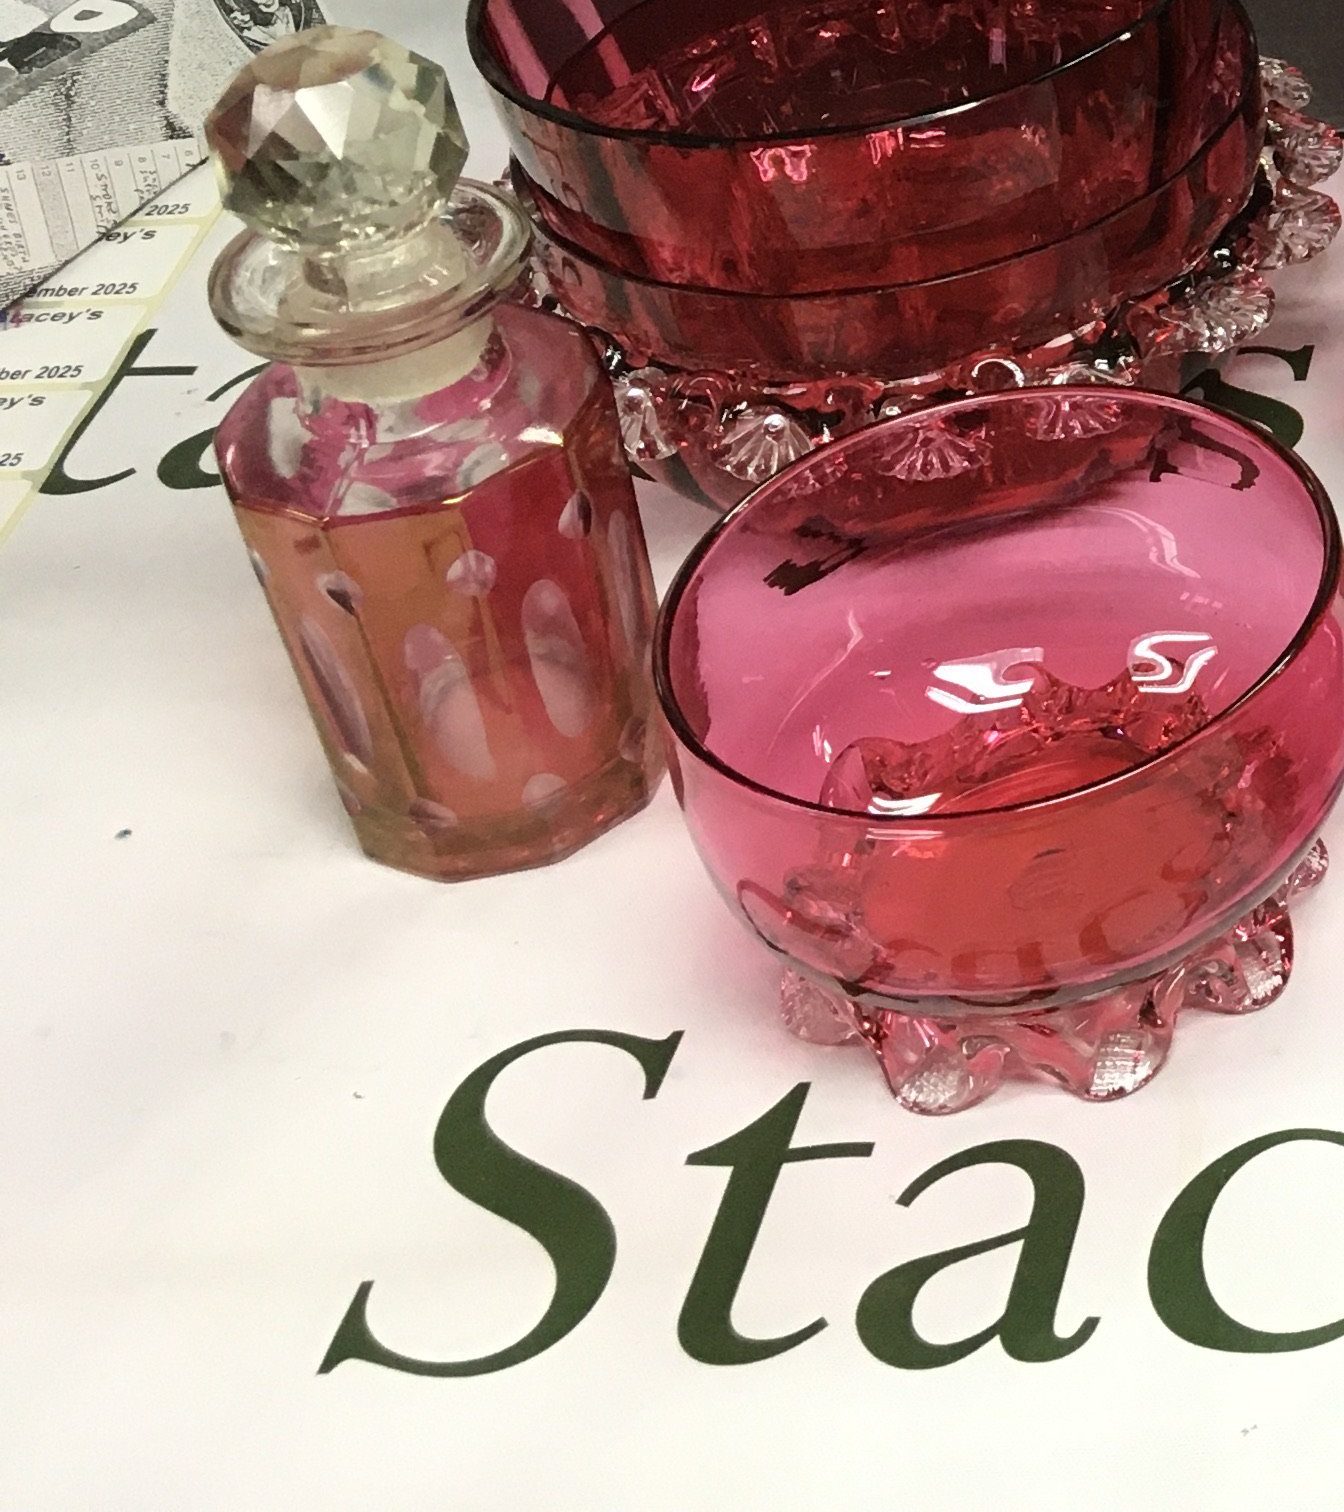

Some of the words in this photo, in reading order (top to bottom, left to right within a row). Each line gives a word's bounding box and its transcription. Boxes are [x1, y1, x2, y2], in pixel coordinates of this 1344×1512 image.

[144, 202, 191, 217] 2025
[104, 228, 157, 243] ey's
[91, 282, 139, 297] 2025
[34, 364, 84, 380] 2025
[0, 452, 24, 467] 25
